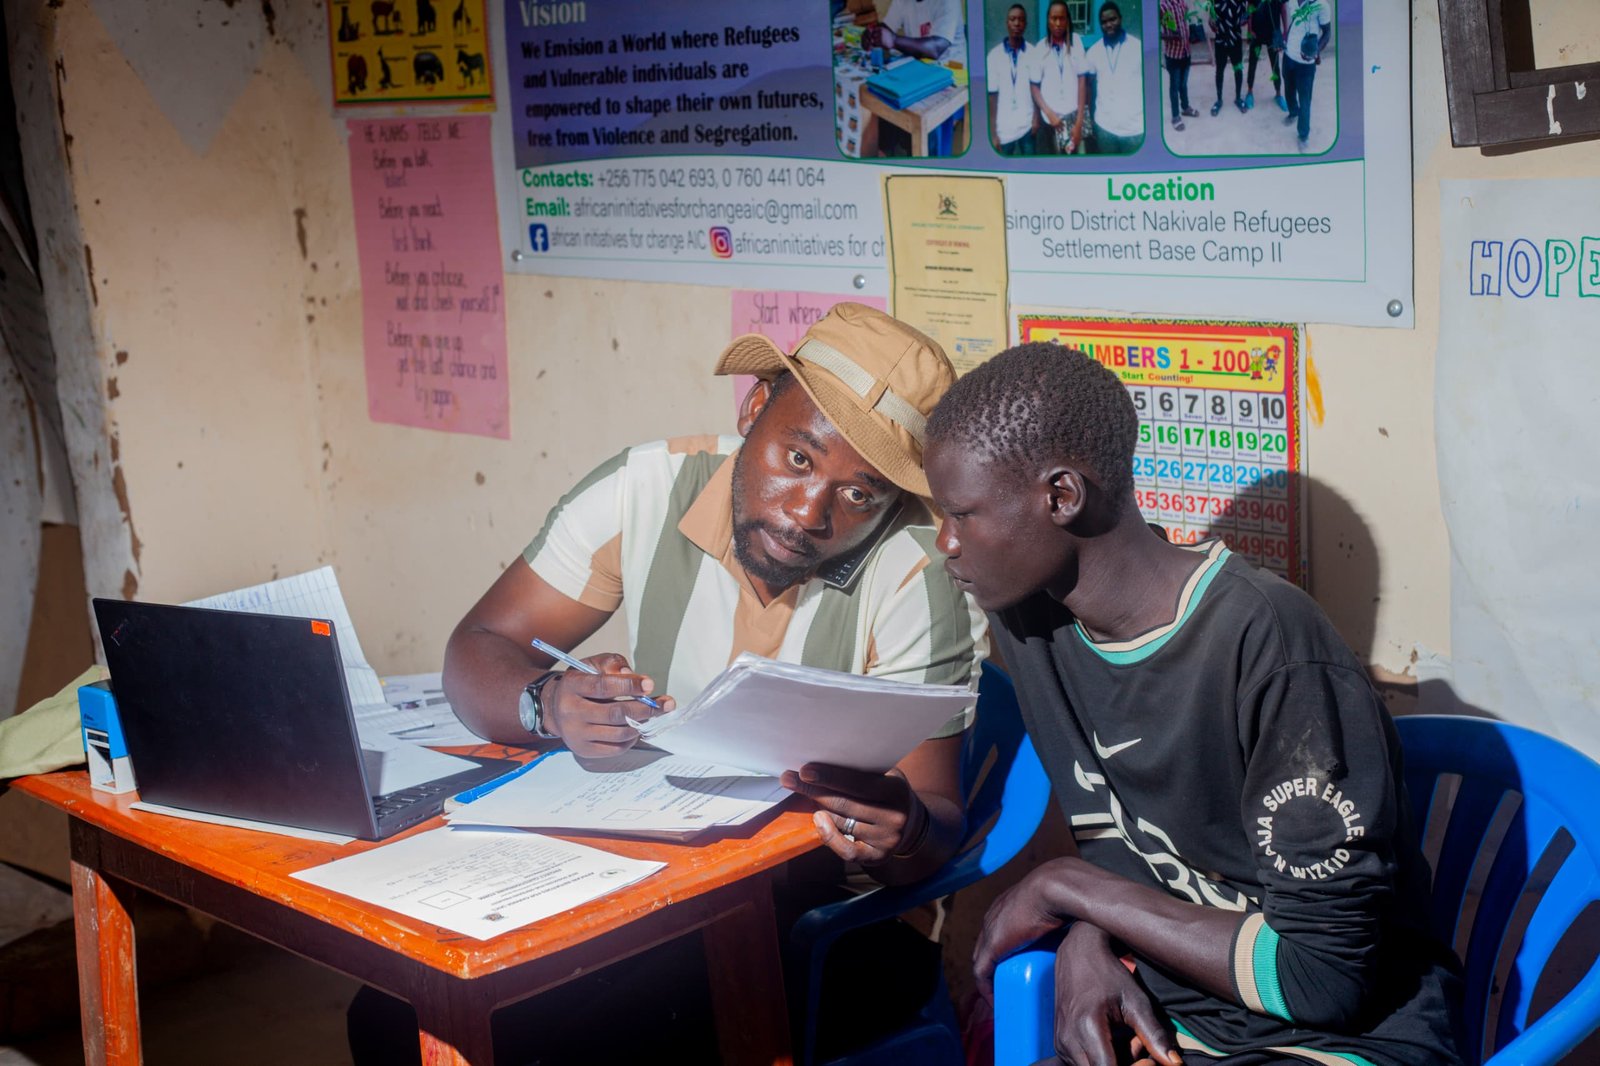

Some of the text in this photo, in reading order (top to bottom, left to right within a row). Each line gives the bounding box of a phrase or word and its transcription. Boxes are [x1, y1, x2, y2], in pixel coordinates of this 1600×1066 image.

[519, 0, 586, 27] Vision
[521, 25, 800, 59] We Envision a World where Refugees
[523, 60, 749, 89] and Vulnerable individuals are
[525, 90, 824, 121] empowered to shape their own futures,
[527, 122, 798, 147] free from Violence and Segregation.
[522, 167, 826, 190] Contacts: +256 775 042 693, 0 760 441 064
[1107, 176, 1215, 201] Location
[526, 197, 858, 224] Email: africaninitiativesforchangeaic@gmail.com
[1005, 209, 1332, 239] singiro District Nakivale Refugees
[630, 227, 644, 248] for
[646, 228, 685, 254] change
[687, 230, 707, 251] AIC
[848, 234, 867, 257] for
[1042, 238, 1143, 260] Settlement
[1148, 239, 1196, 261] Base
[1202, 240, 1264, 267] Camp
[750, 292, 823, 325] Start where
[1064, 343, 1171, 370] MBERS
[1179, 348, 1190, 370] 1
[1212, 350, 1250, 373] 100
[1121, 371, 1194, 385] Start Counting!
[1134, 391, 1285, 420] 5 6 7 8 9 10
[1140, 424, 1287, 453] 5 16 17 18 19 20
[1132, 457, 1288, 489] 25 26 27 28 29 30
[1135, 489, 1288, 524] 35 36 37 38 39 40
[1238, 534, 1261, 556] 49
[1263, 537, 1288, 560] 50
[1262, 777, 1318, 812] SUPER
[1289, 848, 1350, 880] WIZKID
